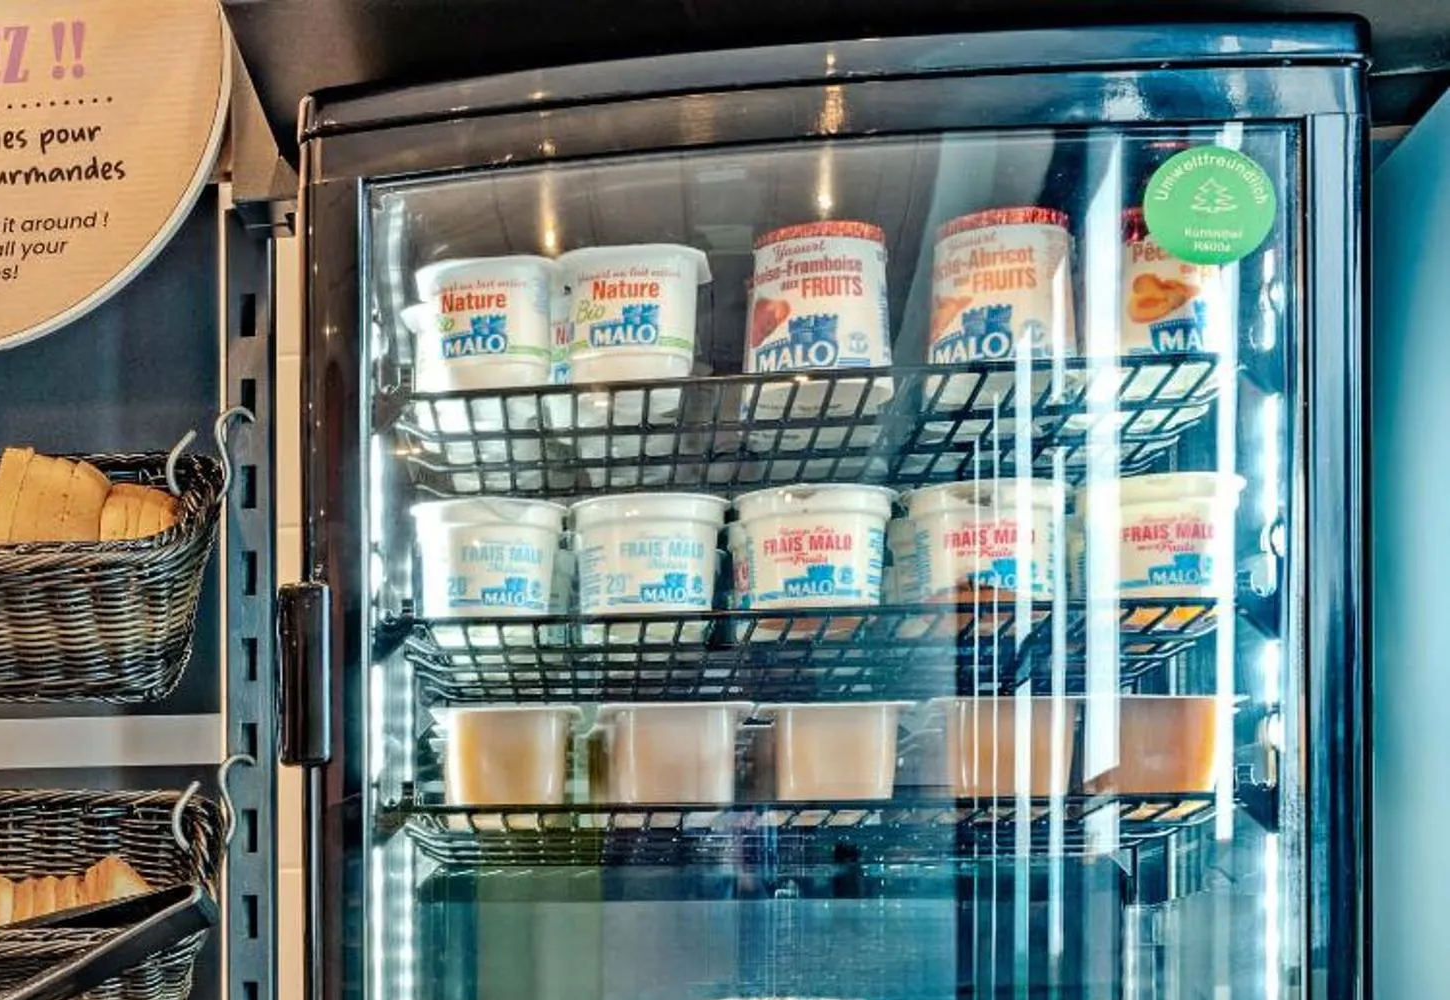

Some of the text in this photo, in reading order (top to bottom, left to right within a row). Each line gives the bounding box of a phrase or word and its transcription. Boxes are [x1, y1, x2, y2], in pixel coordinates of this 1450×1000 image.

[51, 21, 87, 80] !!
[40, 125, 101, 155] pour
[3, 217, 16, 234] it
[21, 211, 98, 233] around
[103, 211, 110, 228] !
[21, 240, 68, 261] your
[593, 280, 660, 300] Nature
[801, 275, 864, 299] FRUITS
[973, 267, 1038, 293] FRUITS
[441, 292, 507, 313] Nature
[443, 333, 507, 358] MALO
[592, 323, 657, 346] MALO
[758, 340, 837, 372] MALO
[933, 331, 1011, 364] MALO
[944, 528, 987, 549] FRAIS
[1122, 524, 1169, 542] FRAIS
[763, 534, 853, 556] FRAIS MALO
[788, 580, 832, 597] MALO
